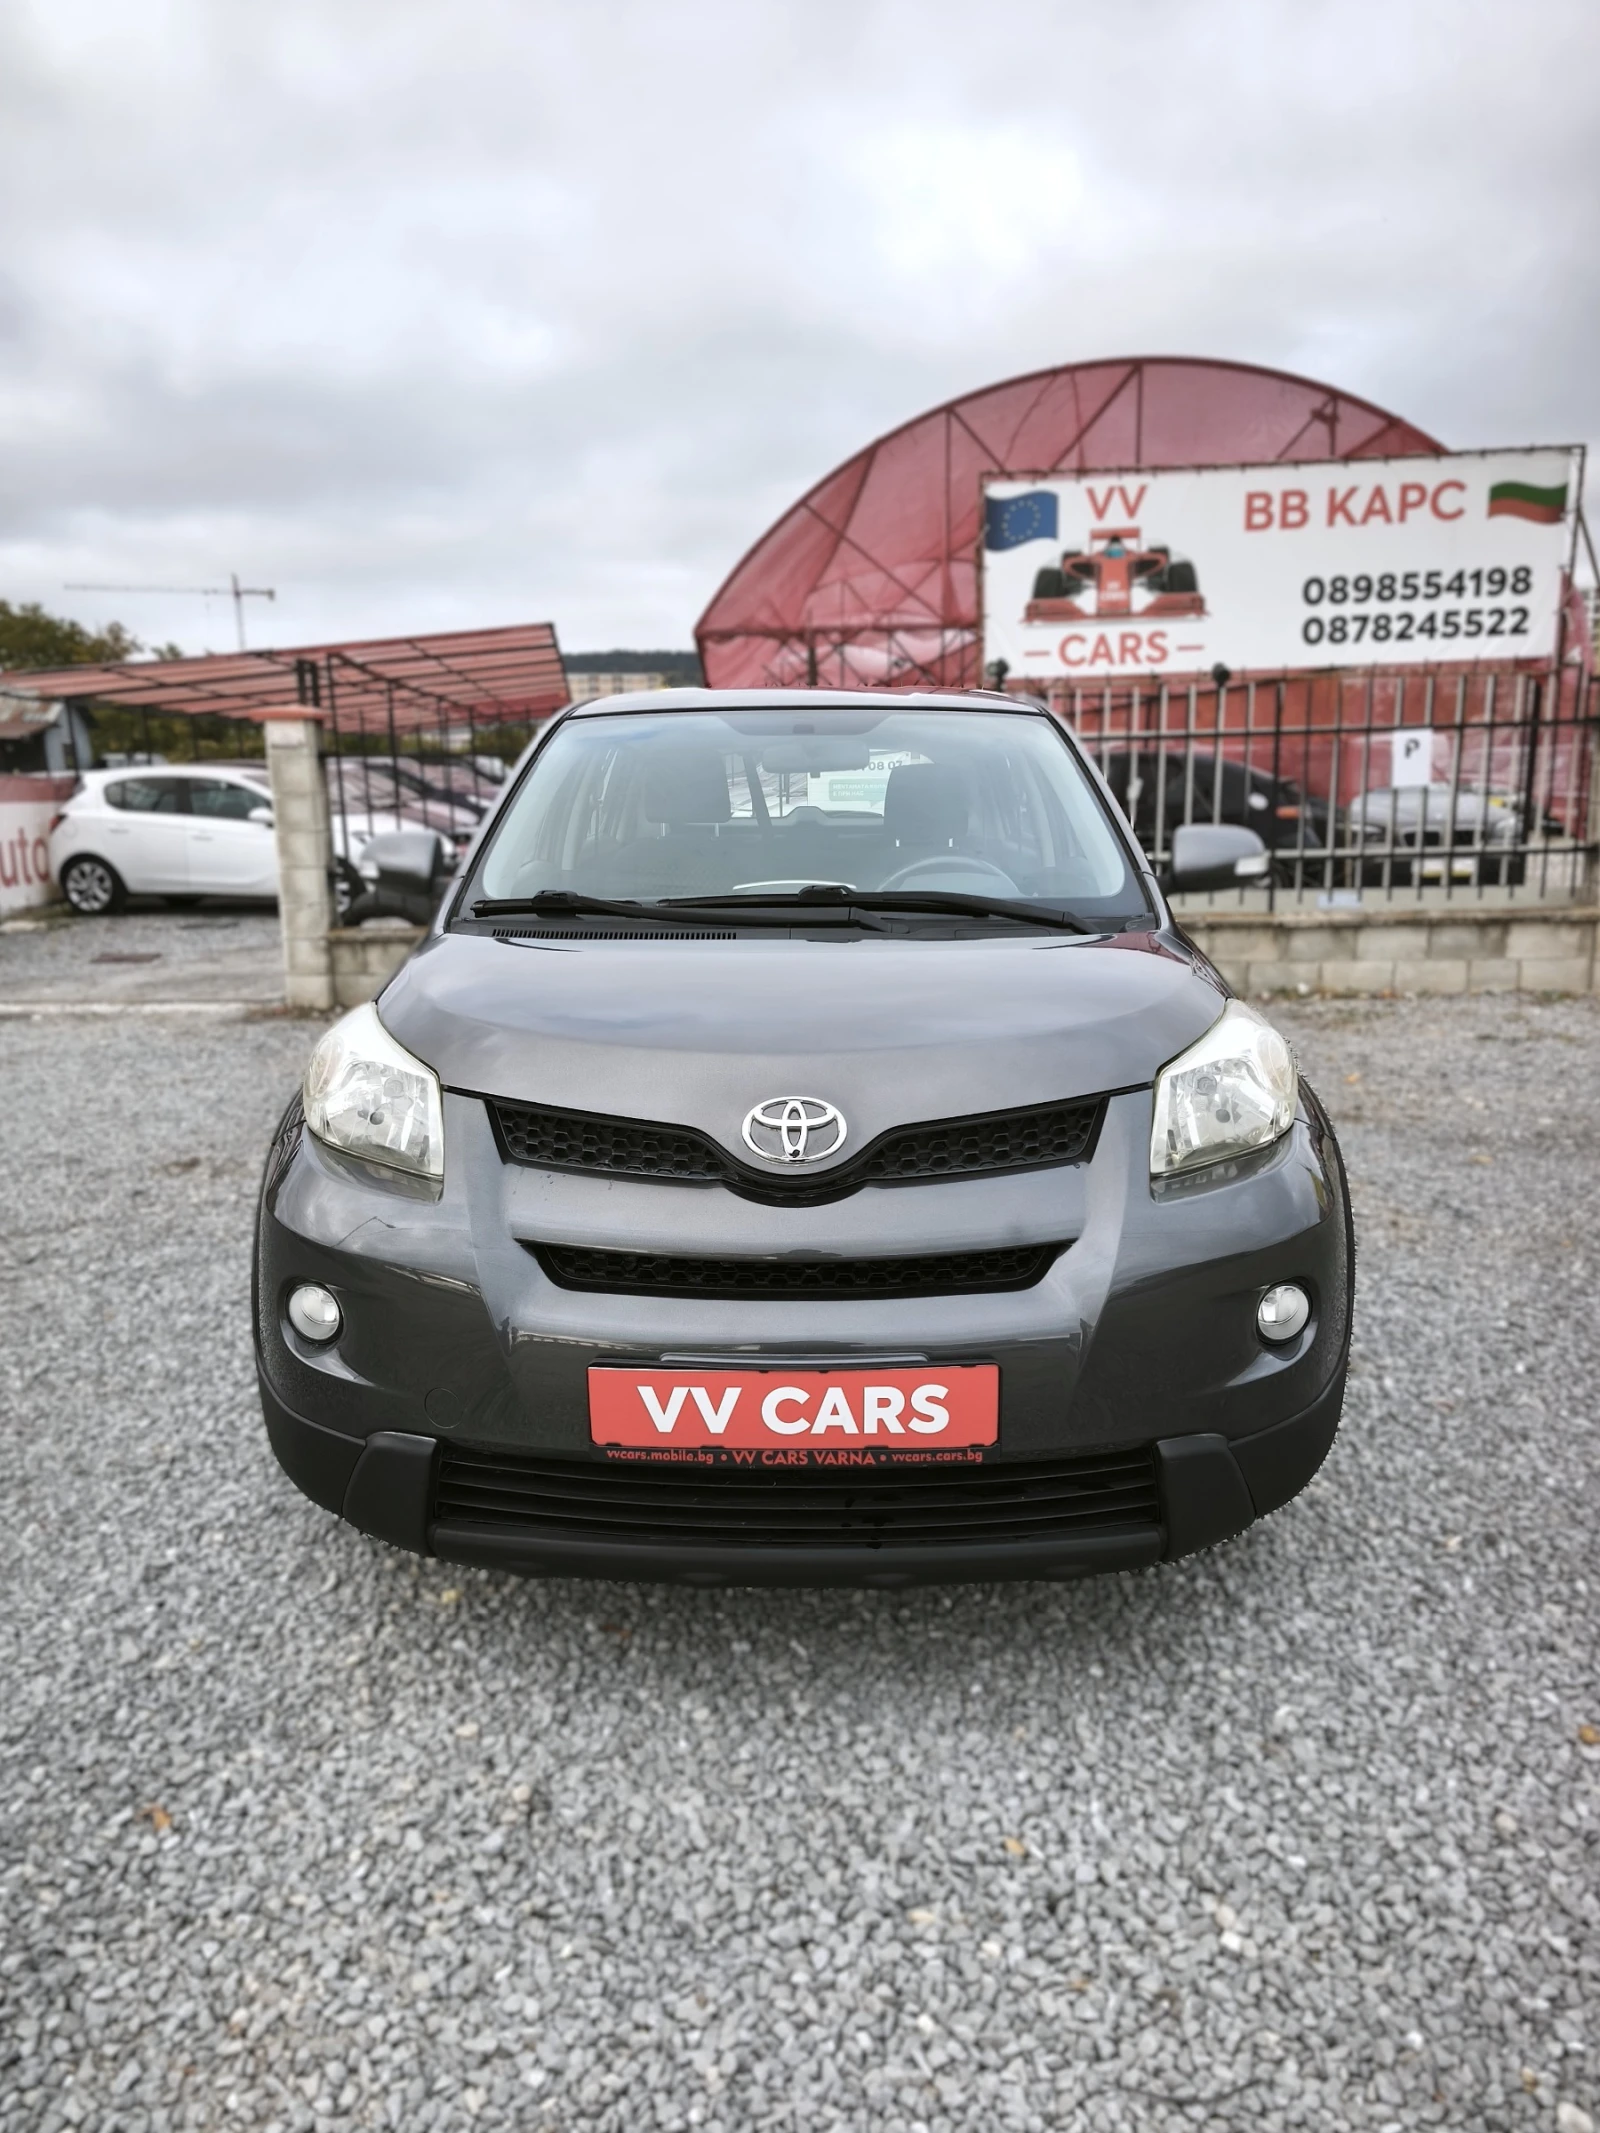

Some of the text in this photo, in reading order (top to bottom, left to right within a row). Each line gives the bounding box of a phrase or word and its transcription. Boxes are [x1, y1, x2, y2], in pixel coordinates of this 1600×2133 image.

[1086, 484, 1148, 521] VV
[1243, 480, 1467, 531] ВВ КАРС
[1303, 565, 1532, 605] 0898554198
[1303, 606, 1530, 646] 0878245522
[1058, 631, 1169, 667] CARS
[637, 1384, 950, 1434] VV CARS
[606, 1449, 983, 1466] vvcars.mobile.bg VV CARS VARNA vvcars.cars.bg
